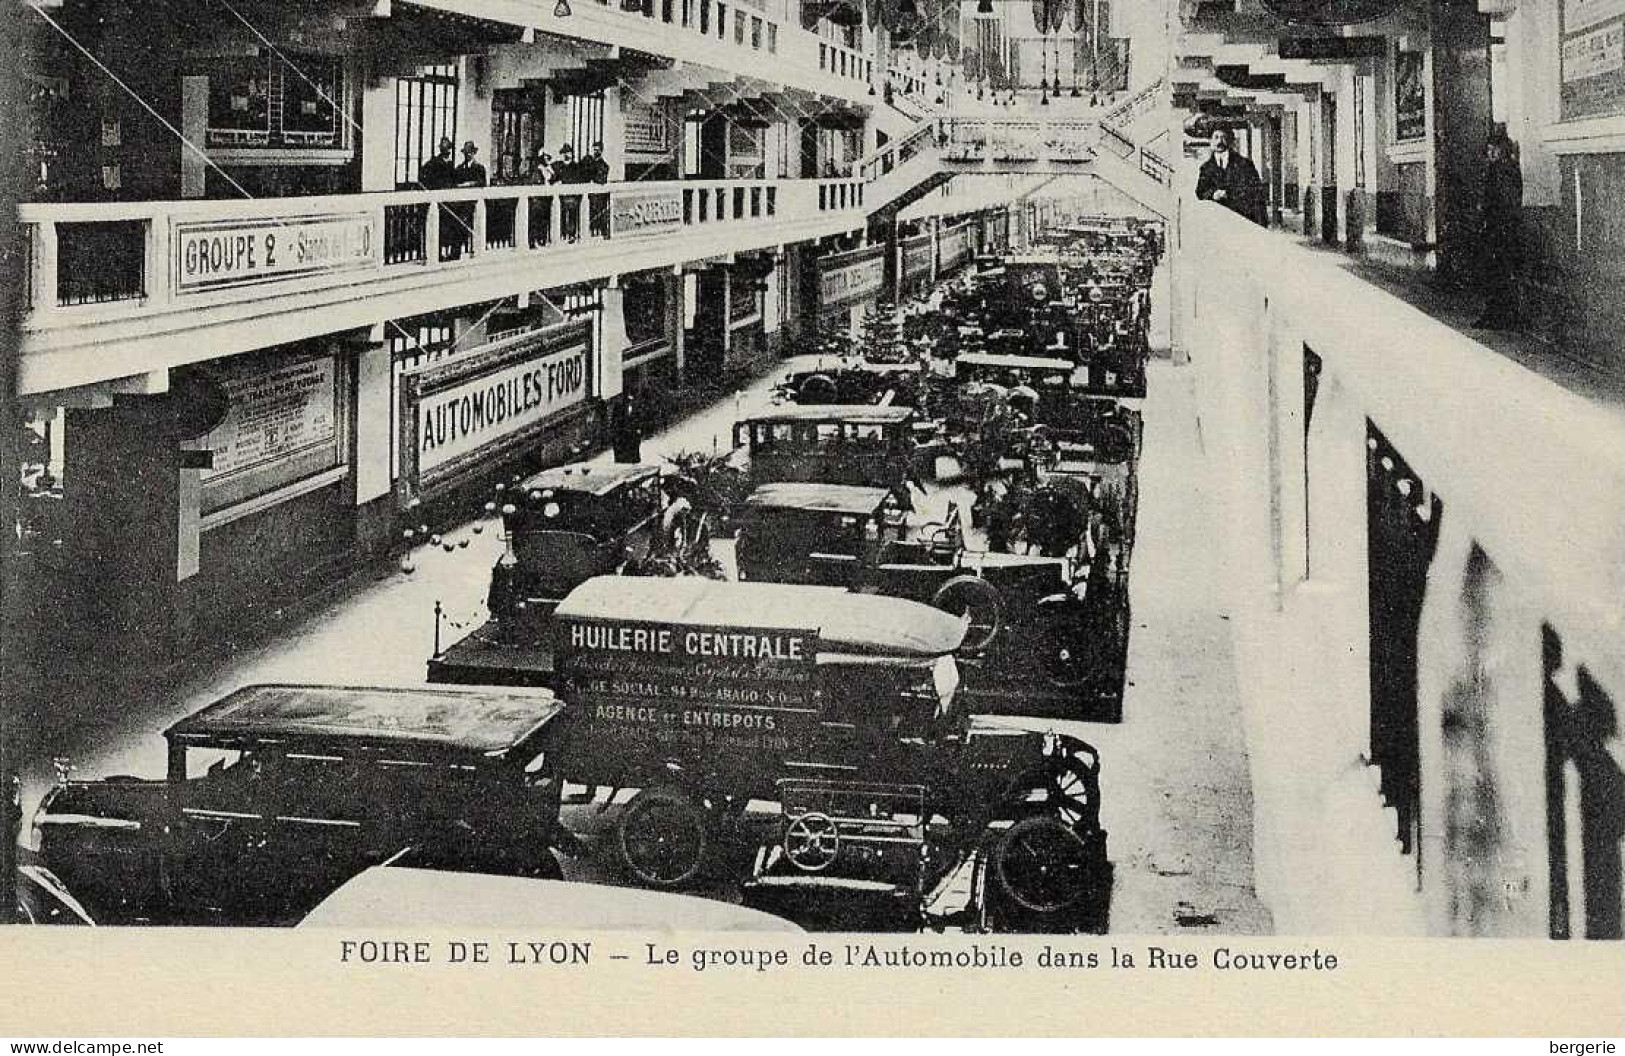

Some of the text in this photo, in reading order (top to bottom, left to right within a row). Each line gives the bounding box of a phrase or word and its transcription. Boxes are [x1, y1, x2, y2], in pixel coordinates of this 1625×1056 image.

[186, 234, 257, 275] GROUPE
[264, 233, 276, 267] 2
[423, 369, 542, 452] AUTOMOBILES
[571, 625, 804, 660] HUILERIE CENTRALE
[612, 680, 660, 697] SOCIAL
[596, 705, 657, 723] AGENCE
[683, 711, 777, 731] ENTREPOTS
